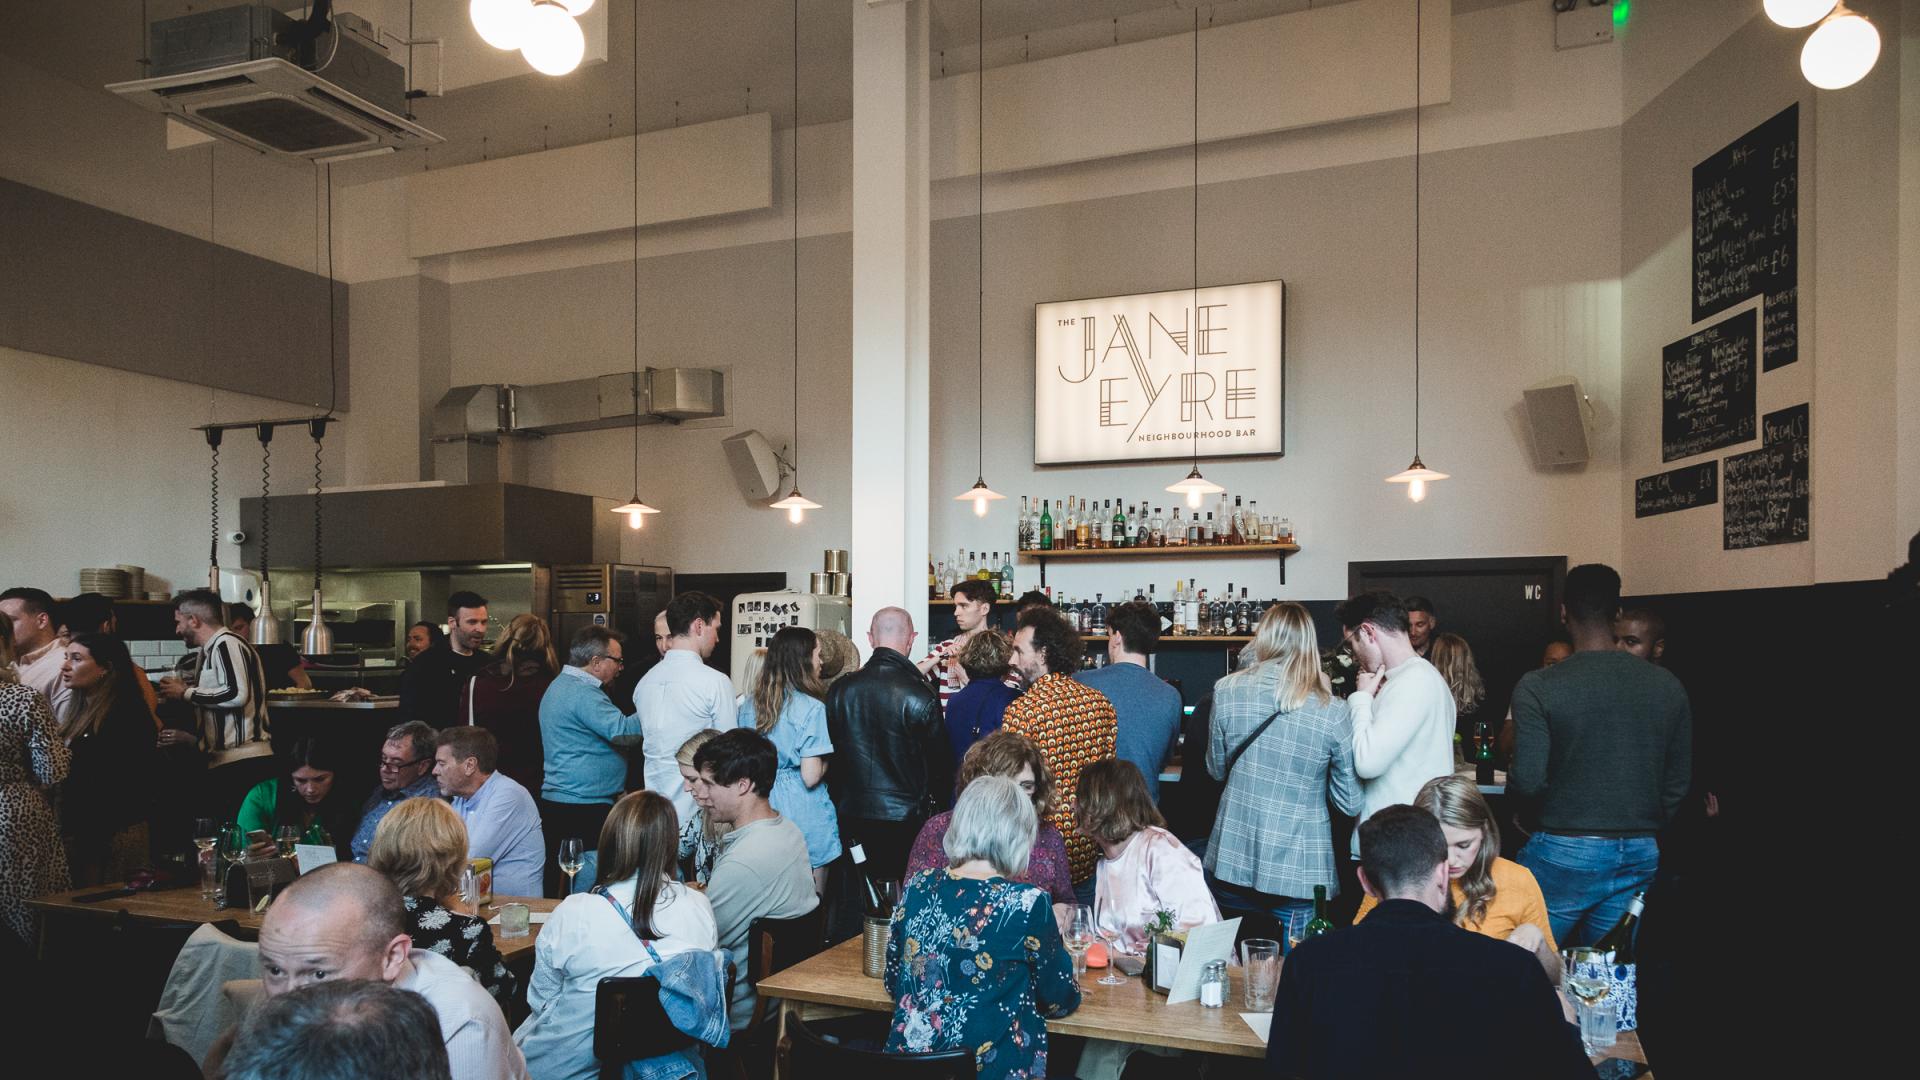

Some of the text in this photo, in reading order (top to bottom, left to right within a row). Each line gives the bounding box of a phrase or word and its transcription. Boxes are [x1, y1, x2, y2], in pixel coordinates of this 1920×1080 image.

[1057, 318, 1075, 327] THE
[1058, 304, 1228, 384] JANE
[1100, 369, 1256, 443] EYRE
[1138, 429, 1256, 442] NEIGHBOURHOOD BAR
[1525, 585, 1541, 600] WC
